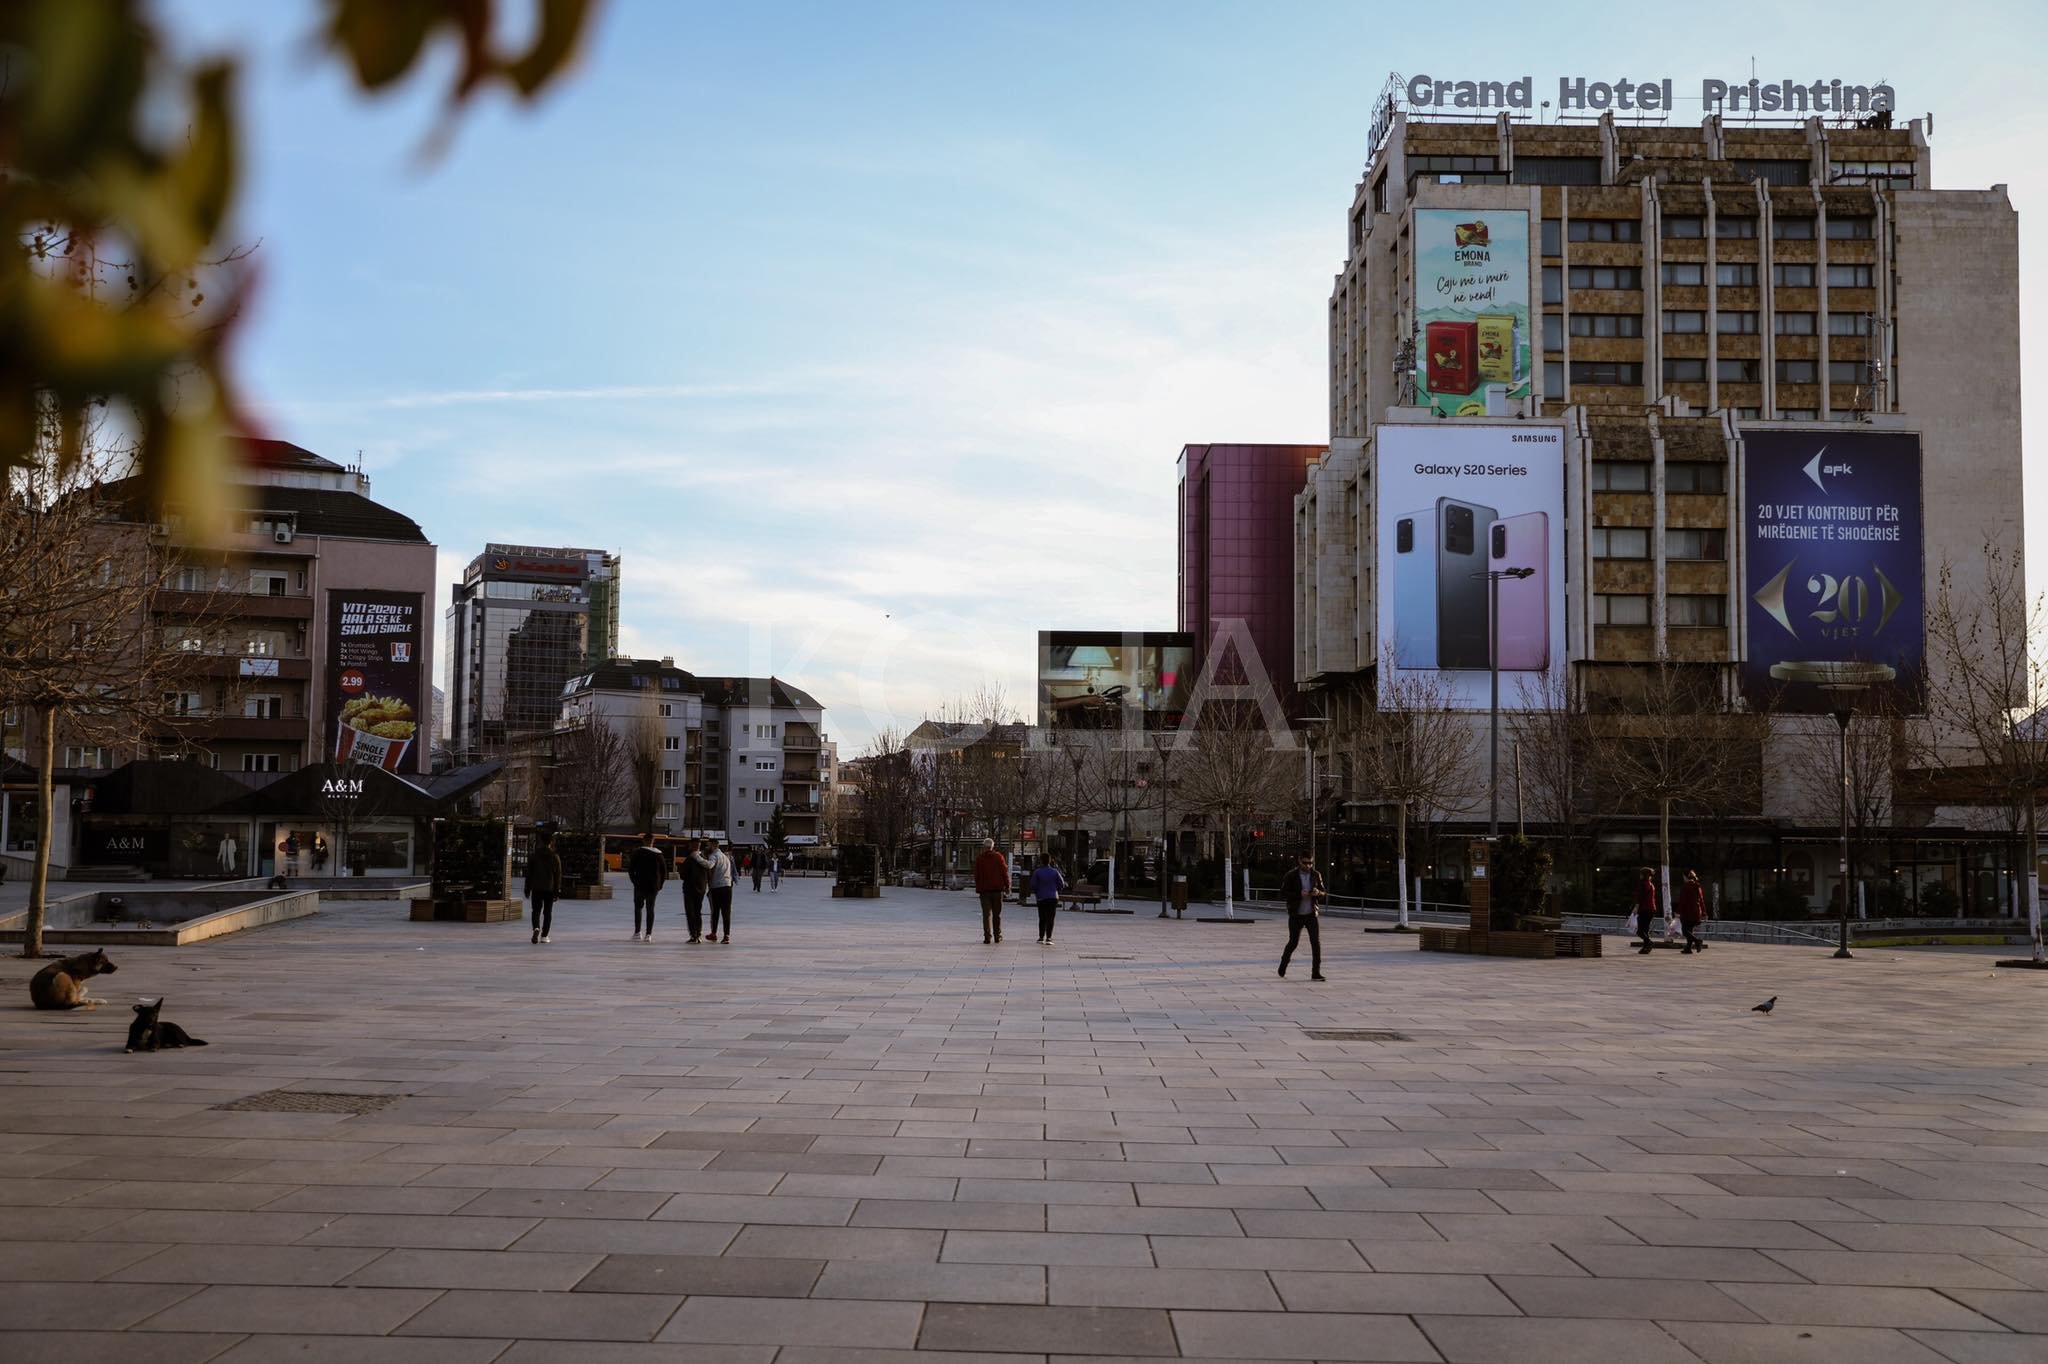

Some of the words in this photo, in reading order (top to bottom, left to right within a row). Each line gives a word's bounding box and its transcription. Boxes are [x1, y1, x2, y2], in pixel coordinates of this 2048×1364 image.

[1408, 75, 1532, 108] Grand
[1560, 77, 1672, 110] Hotel
[1703, 79, 1895, 112] Prishtina
[1454, 251, 1491, 262] EMONA
[1470, 287, 1496, 301] vend!
[1512, 435, 1557, 443] SAMSUNG
[1414, 464, 1461, 477] Galaxy
[1464, 465, 1486, 476] S20
[1488, 465, 1528, 476] Series
[1759, 505, 1772, 519] 20
[1777, 505, 1804, 520] VJET
[1808, 506, 1872, 521] KONTRIBUT
[1877, 505, 1899, 522] PËR
[1759, 523, 1818, 539] MIRËQENIE
[1821, 524, 1834, 540] TË
[1838, 525, 1900, 541] SHOQËRISË
[1808, 574, 1868, 623] 20
[343, 603, 367, 614] VITI
[368, 604, 397, 614] 2020
[397, 606, 404, 614] E
[405, 607, 413, 615] TI
[341, 614, 375, 624] HALA
[376, 615, 389, 624] SE
[390, 615, 402, 624] KE
[341, 625, 379, 635] SHIJU
[380, 624, 413, 634] SINGLE
[343, 677, 362, 686] 2.99
[356, 741, 385, 755] SINGLE
[322, 779, 363, 793] A&M
[107, 837, 145, 849] A&M
